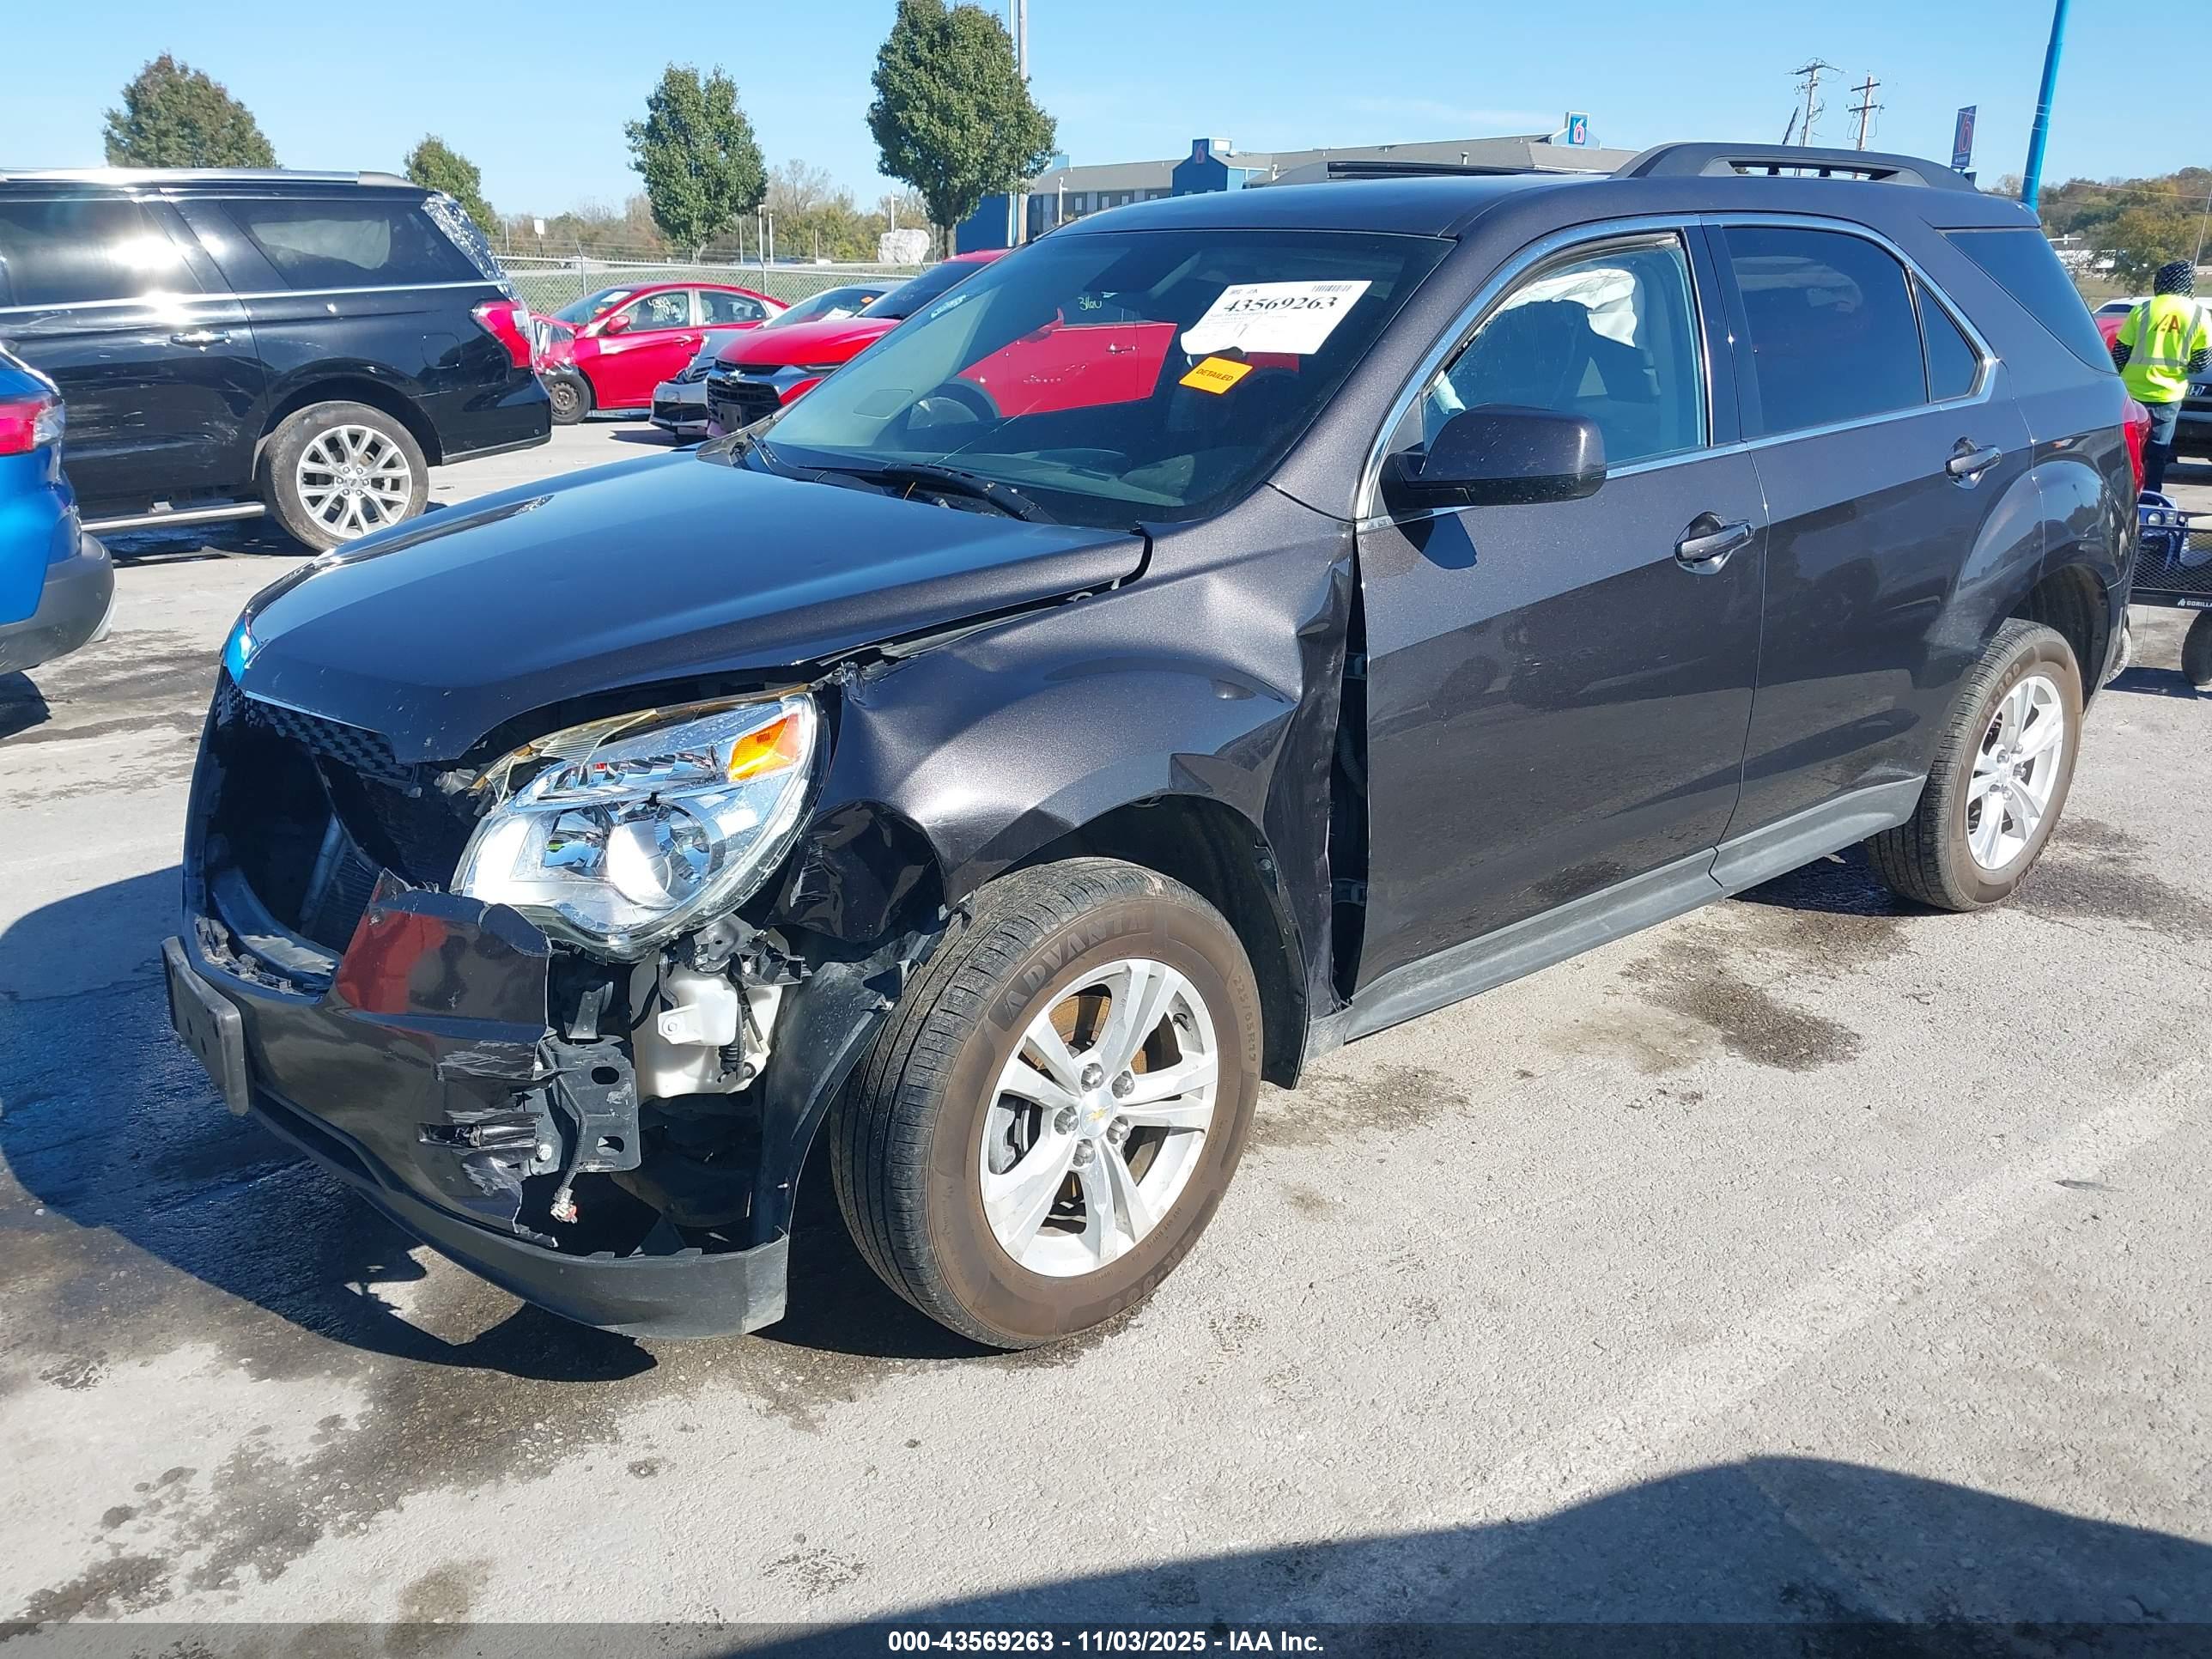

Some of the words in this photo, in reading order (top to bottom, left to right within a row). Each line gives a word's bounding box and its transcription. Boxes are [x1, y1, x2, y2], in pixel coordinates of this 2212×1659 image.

[1573, 118, 1585, 143] 6
[1959, 107, 1973, 152] 6
[1224, 296, 1338, 313] 43569263
[1195, 368, 1234, 381] DETAILED
[1003, 912, 1148, 1021] ADVANTA
